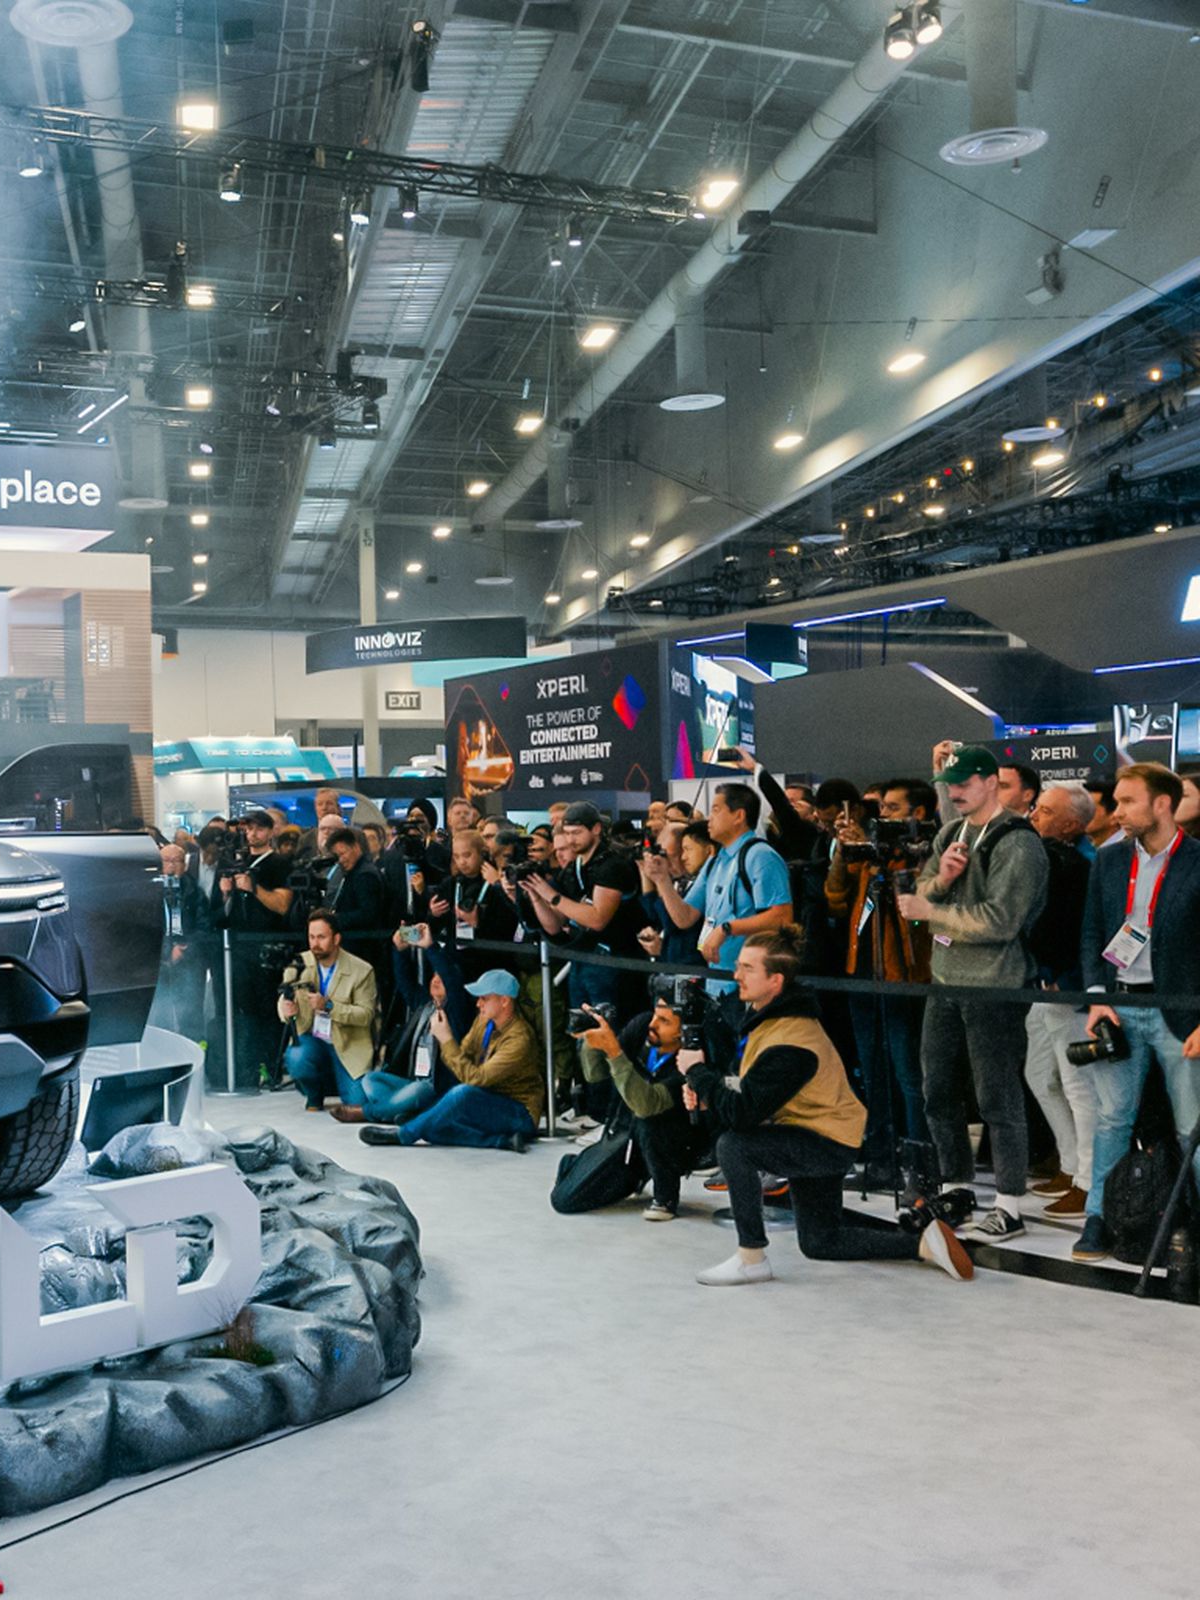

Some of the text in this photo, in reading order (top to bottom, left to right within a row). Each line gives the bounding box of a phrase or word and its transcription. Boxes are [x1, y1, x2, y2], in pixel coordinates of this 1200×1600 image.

[0, 469, 101, 509] place
[354, 631, 422, 651] INNOVIZ
[355, 648, 422, 660] TECHNOLOGIES
[536, 674, 586, 699] XPERI
[388, 694, 419, 708] EXIT
[526, 706, 602, 729] THE POWER OF
[530, 724, 598, 746] CONNECTED
[520, 742, 612, 765] ENTERTAINMENT
[1030, 746, 1076, 761] XPERI
